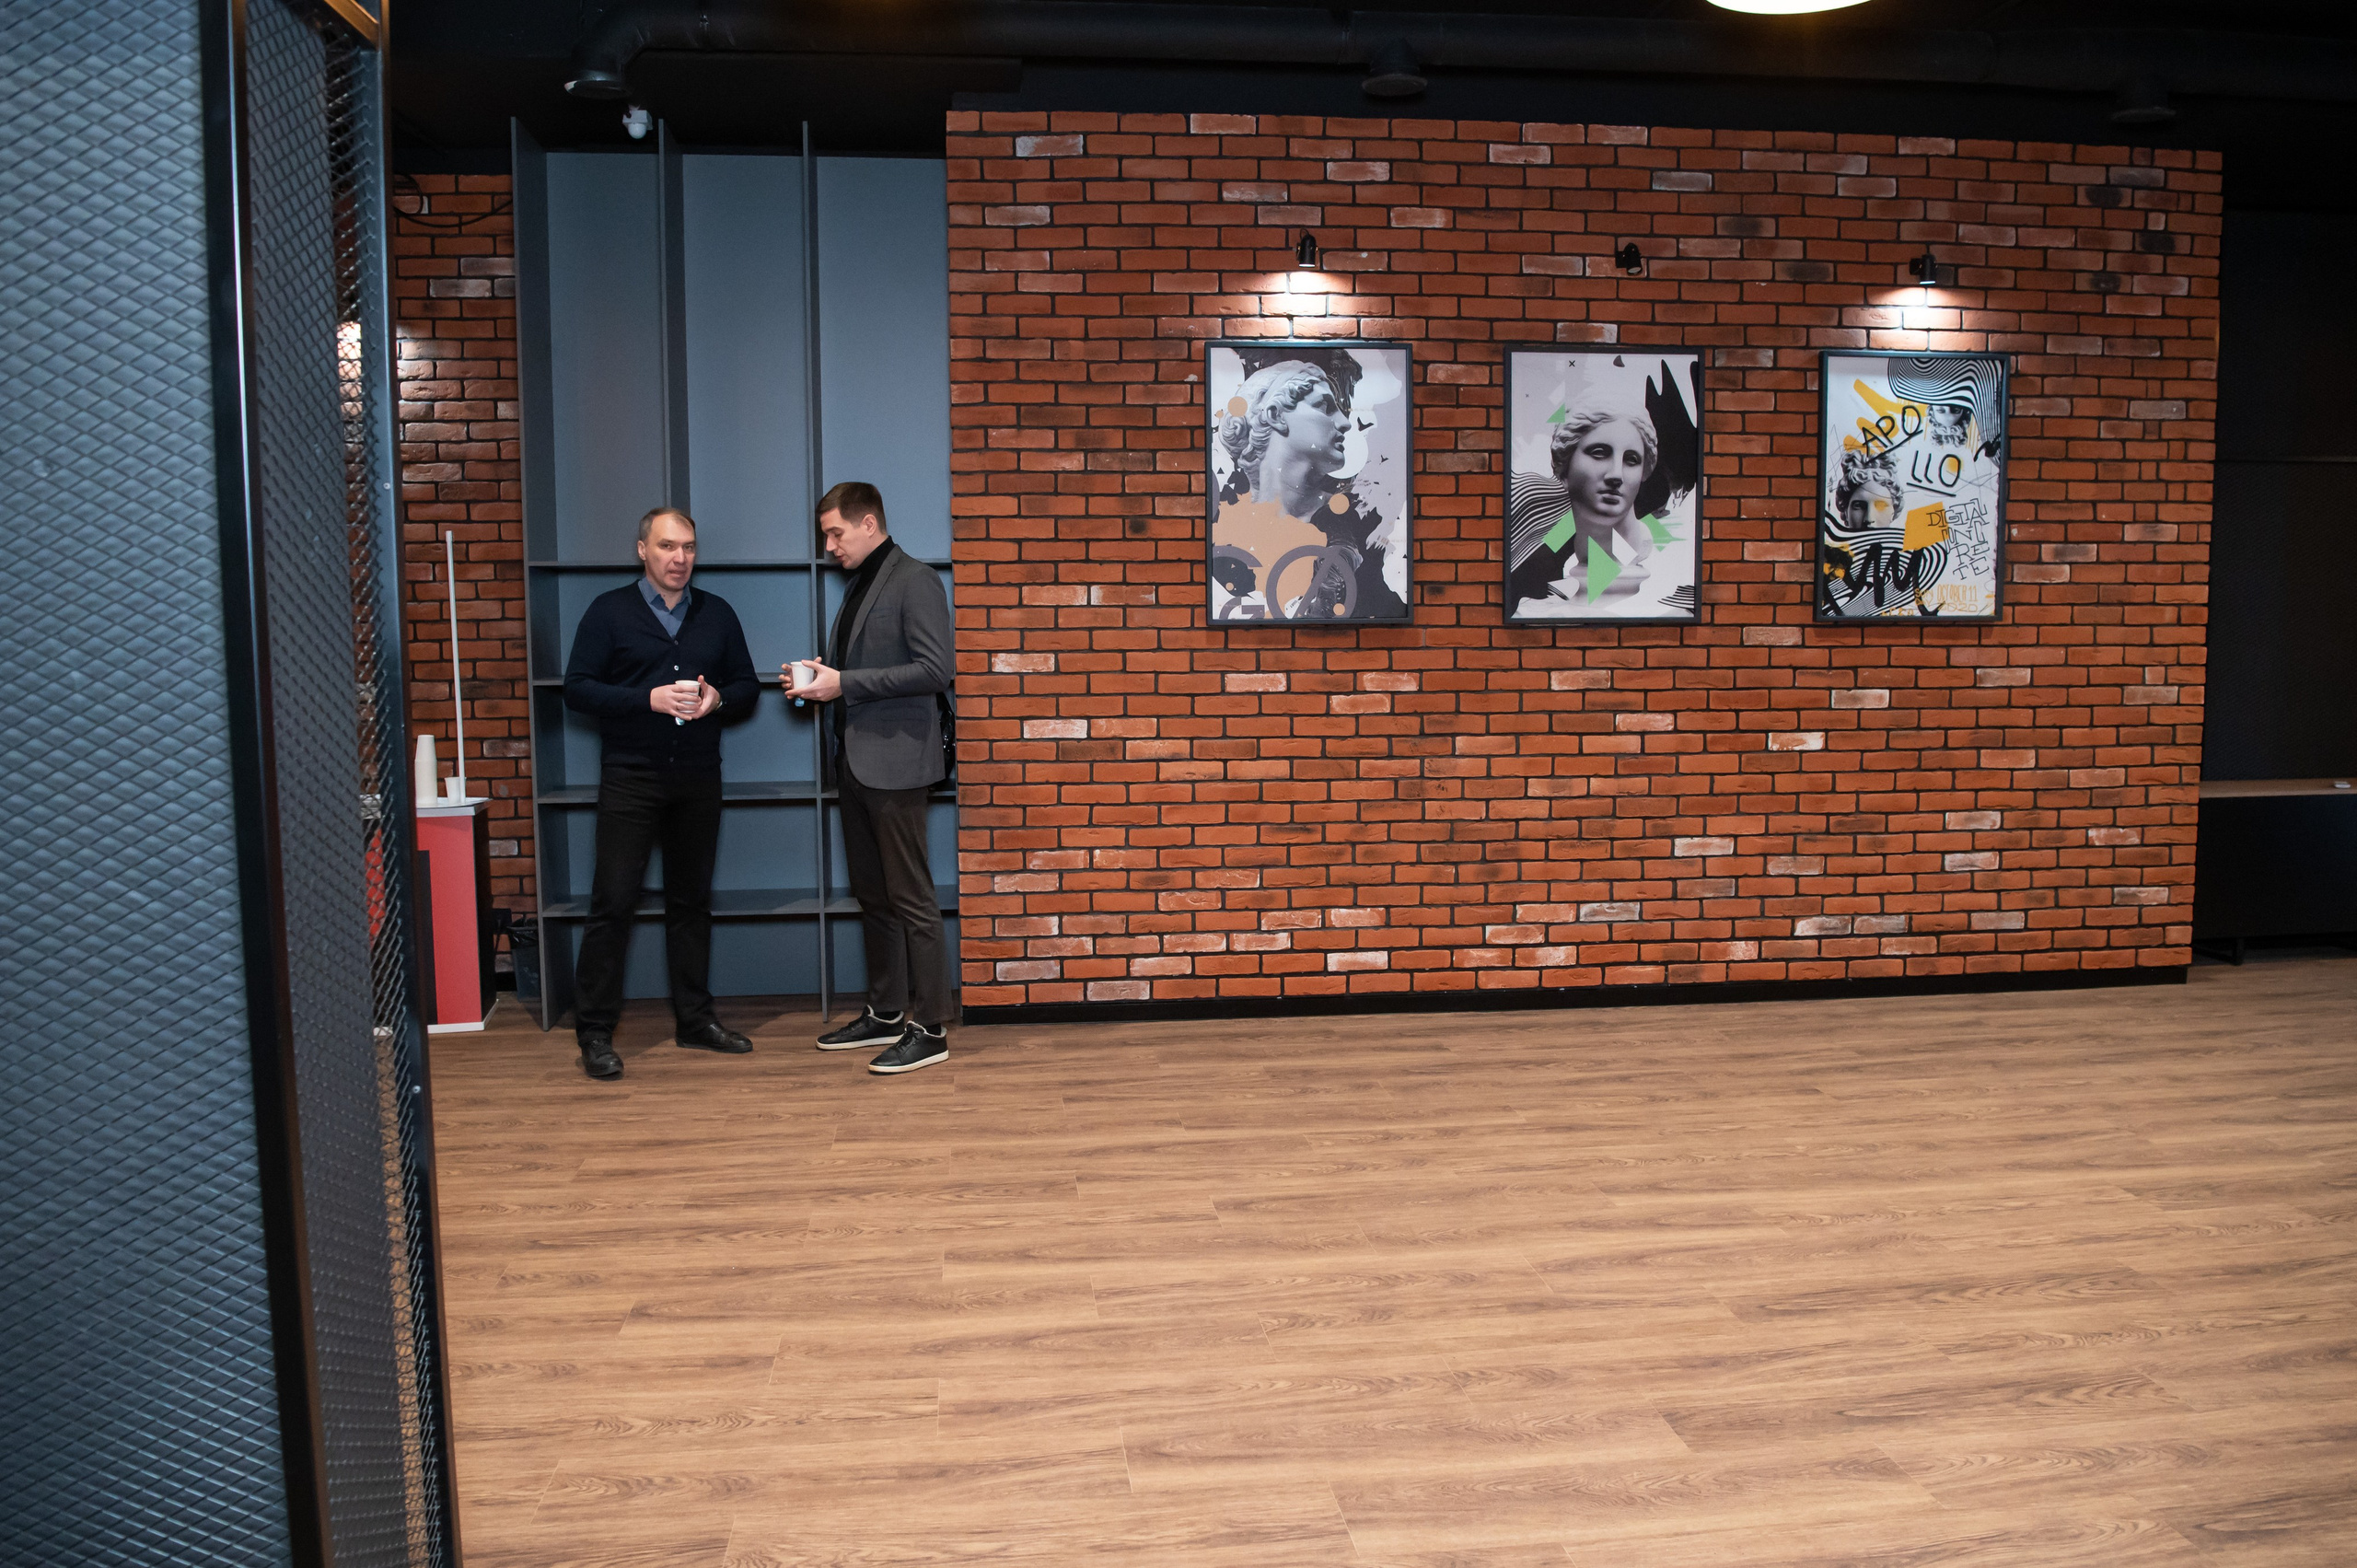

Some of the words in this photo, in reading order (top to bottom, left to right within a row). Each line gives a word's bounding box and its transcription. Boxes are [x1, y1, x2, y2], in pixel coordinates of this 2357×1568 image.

[1862, 405, 1922, 459] APO
[1910, 450, 1962, 488] LLO
[1926, 498, 1991, 528] DIGITAL
[1949, 540, 1991, 566] RE
[1952, 556, 1991, 580] TE
[1936, 584, 1968, 602] OCTOBER
[1968, 585, 1979, 602] 11
